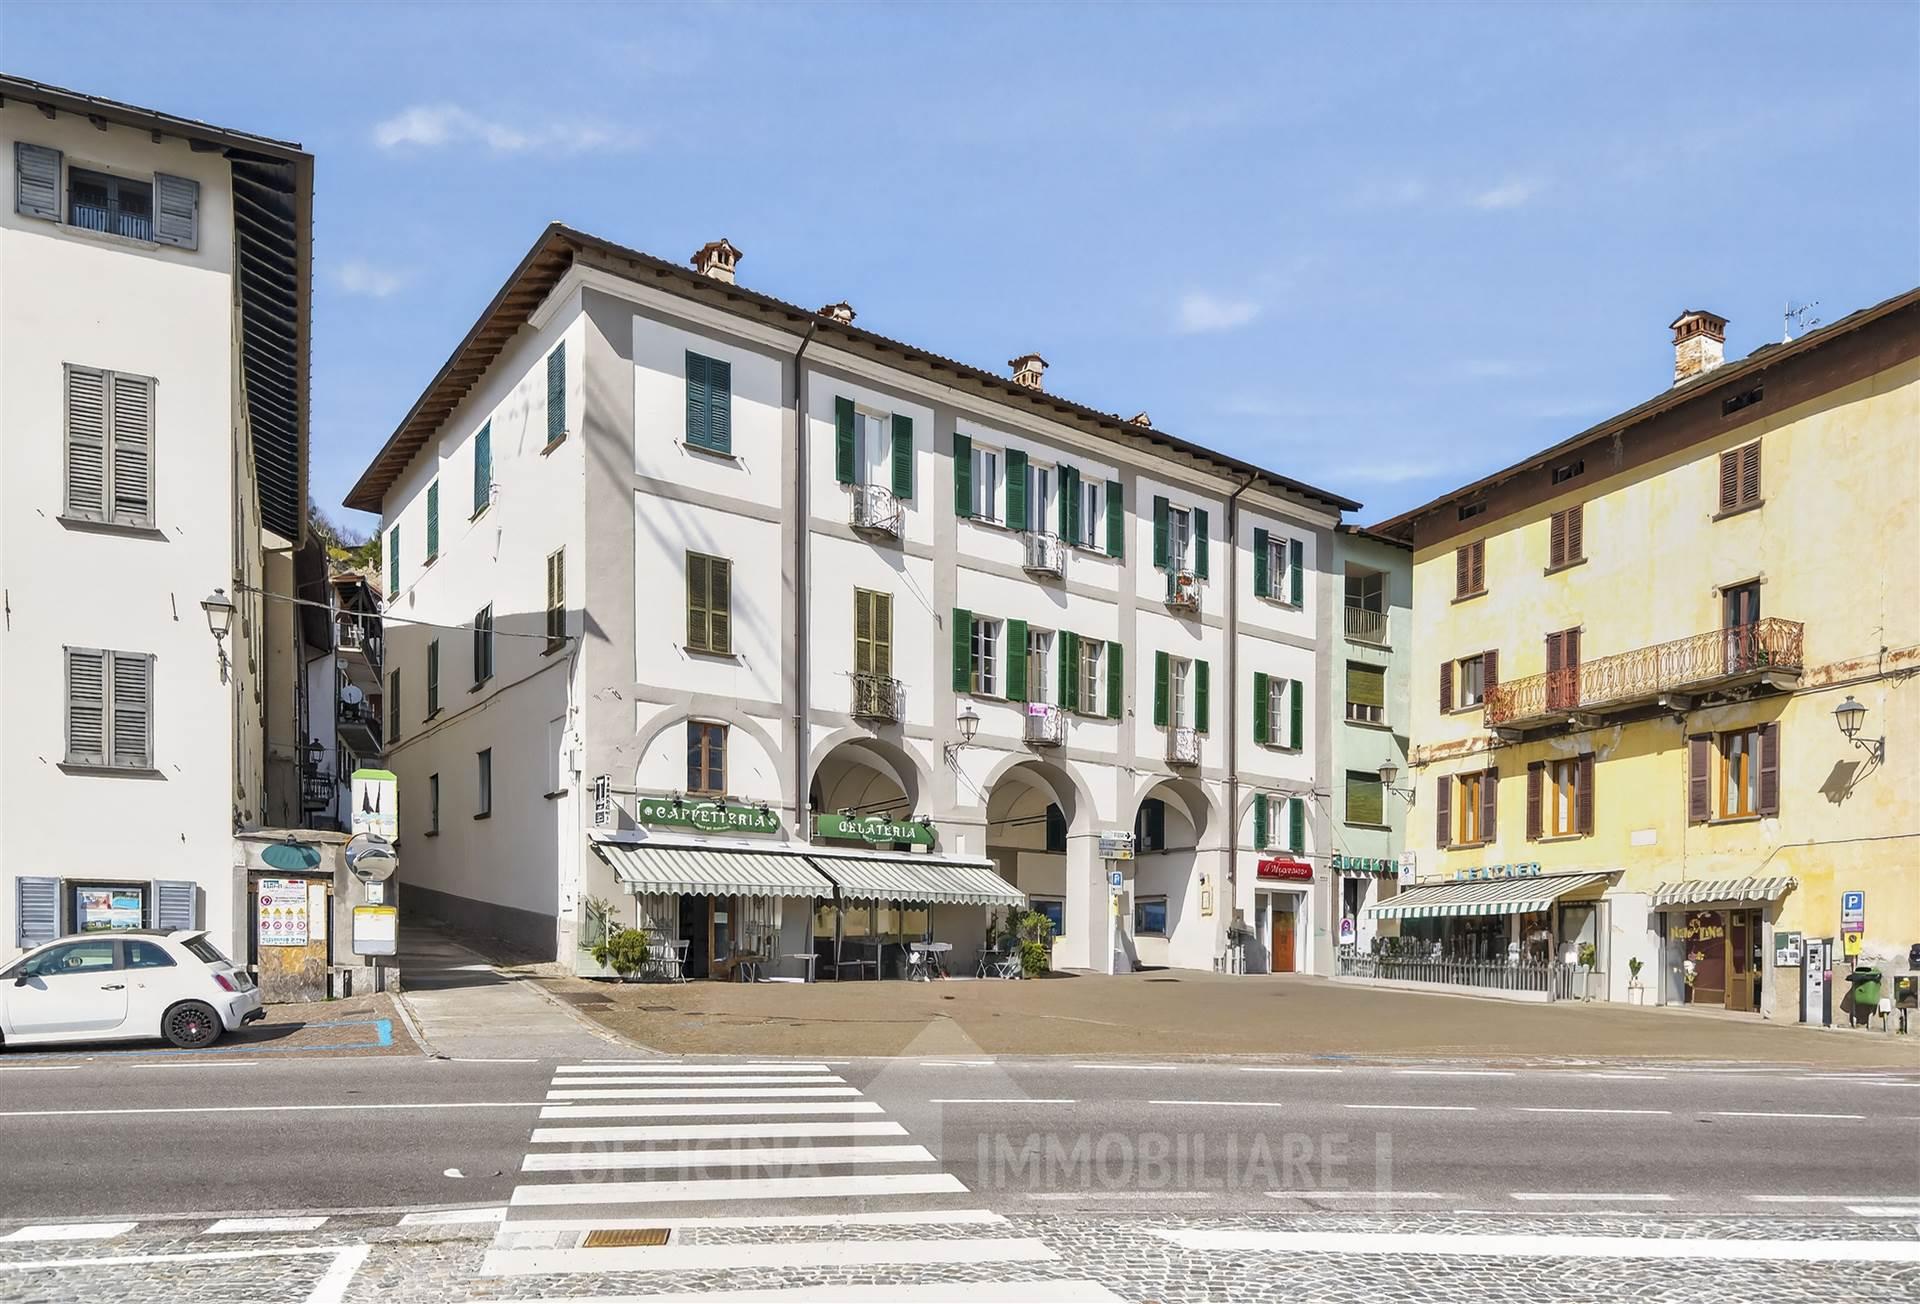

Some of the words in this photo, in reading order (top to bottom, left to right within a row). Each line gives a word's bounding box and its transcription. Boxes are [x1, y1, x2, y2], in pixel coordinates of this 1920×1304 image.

[656, 806, 765, 828] CAFFETTERIA
[838, 820, 916, 839] GELATERIA
[1848, 896, 1858, 908] P
